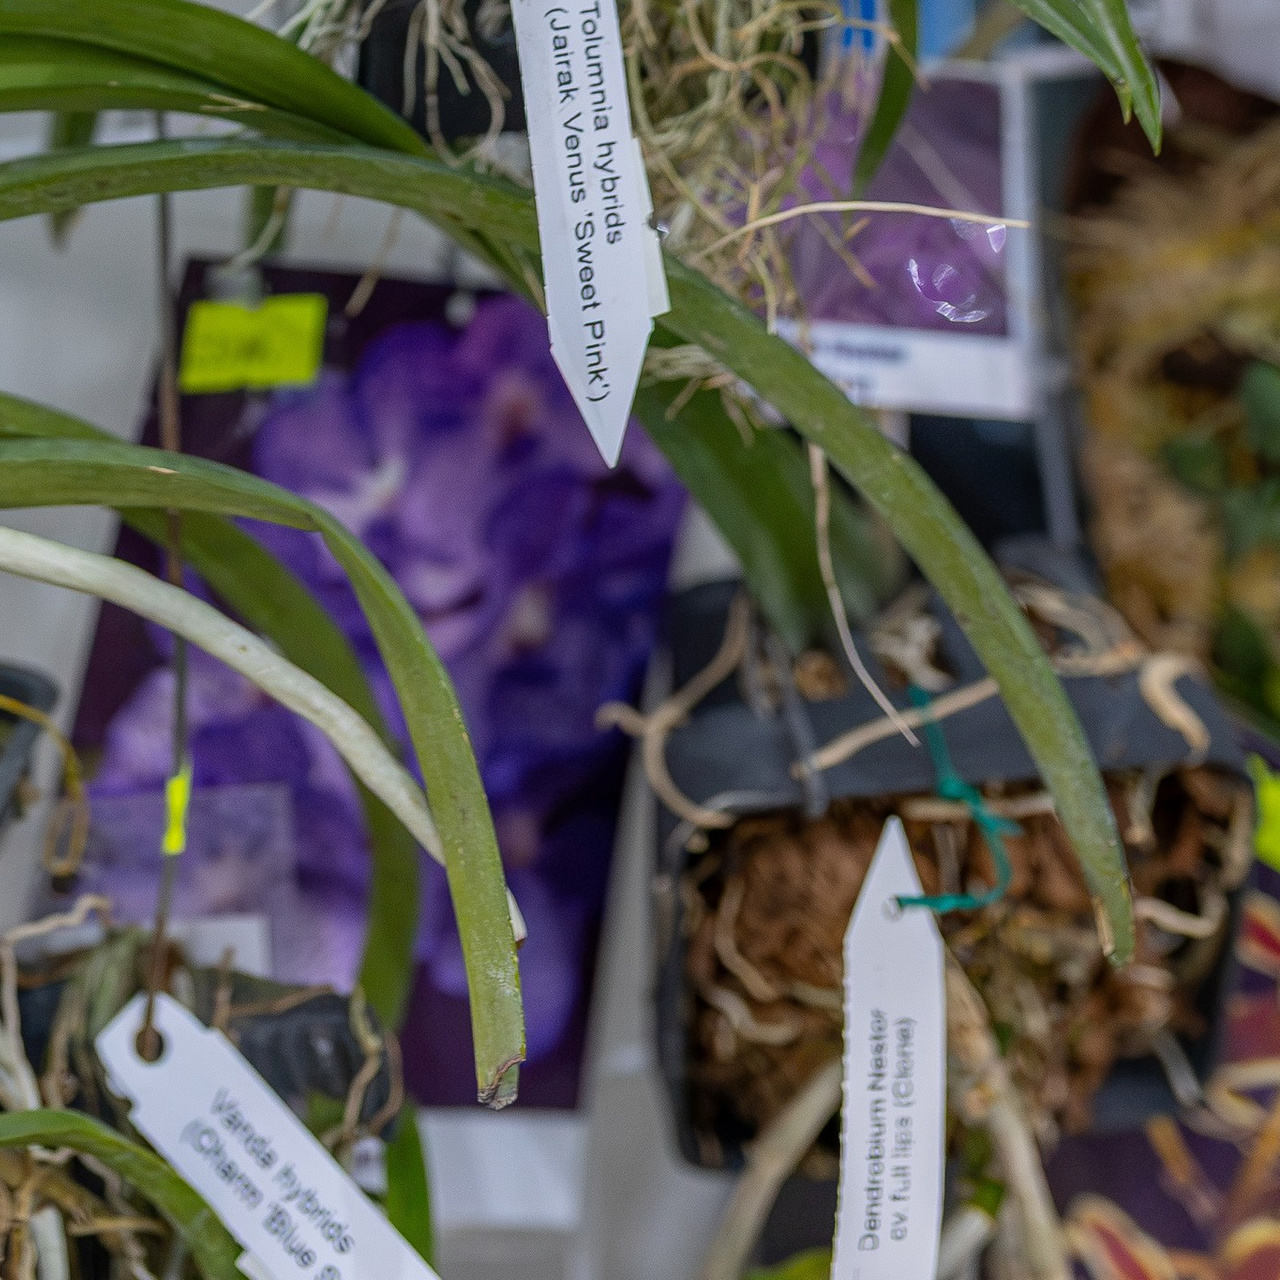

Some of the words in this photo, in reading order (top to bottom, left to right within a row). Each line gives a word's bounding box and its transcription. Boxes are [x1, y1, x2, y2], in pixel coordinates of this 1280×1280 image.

[544, 7, 579, 104] (Jairak
[579, 0, 612, 131] Tolumnia
[563, 111, 586, 204] Venus
[593, 140, 626, 245] hybrids
[575, 211, 601, 312] 'Sweet
[584, 320, 611, 402] Pink')
[210, 1087, 279, 1169] Vanda
[273, 1162, 355, 1255] hybrids
[857, 1098, 887, 1252] Dendrobium
